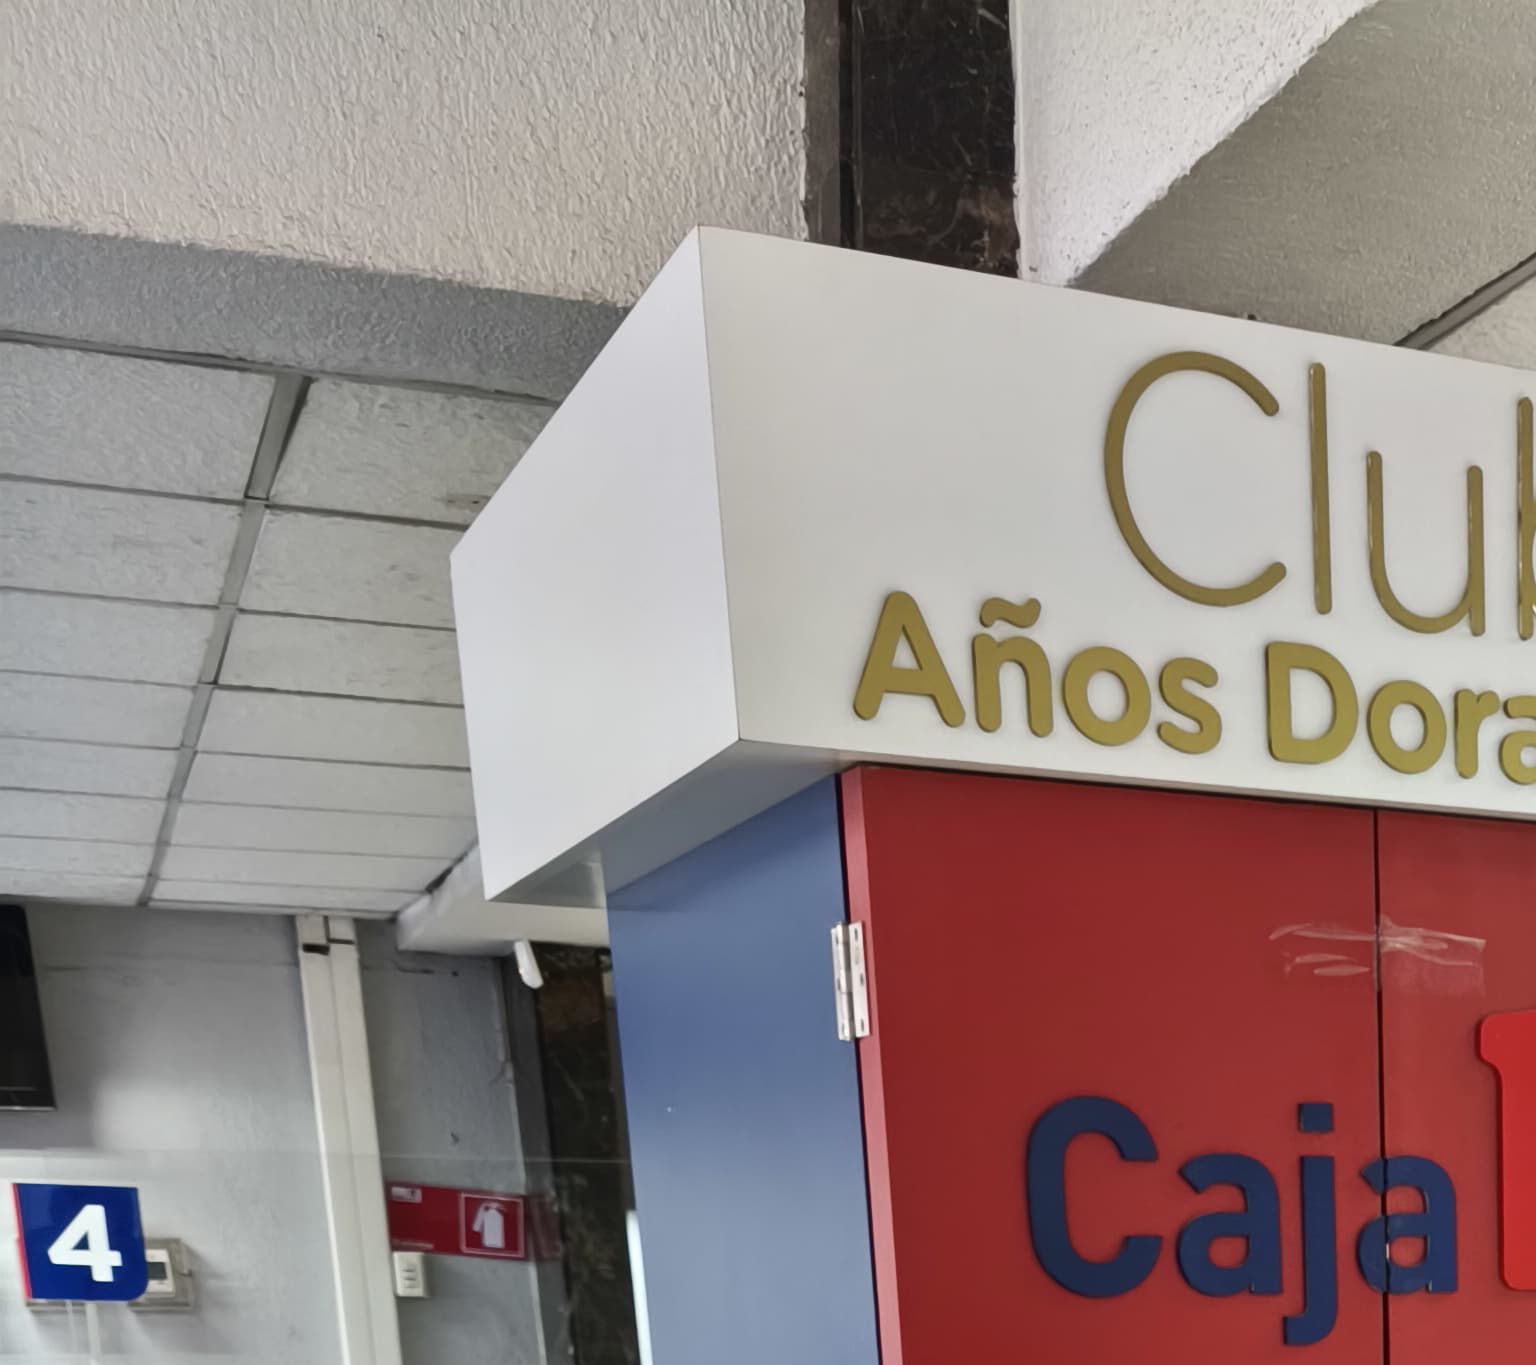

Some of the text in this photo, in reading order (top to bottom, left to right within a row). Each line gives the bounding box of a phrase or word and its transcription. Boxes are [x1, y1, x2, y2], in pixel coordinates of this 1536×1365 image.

[852, 590, 1222, 754] Años
[47, 1204, 123, 1283] 4
[1025, 1095, 1458, 1345] Caja
